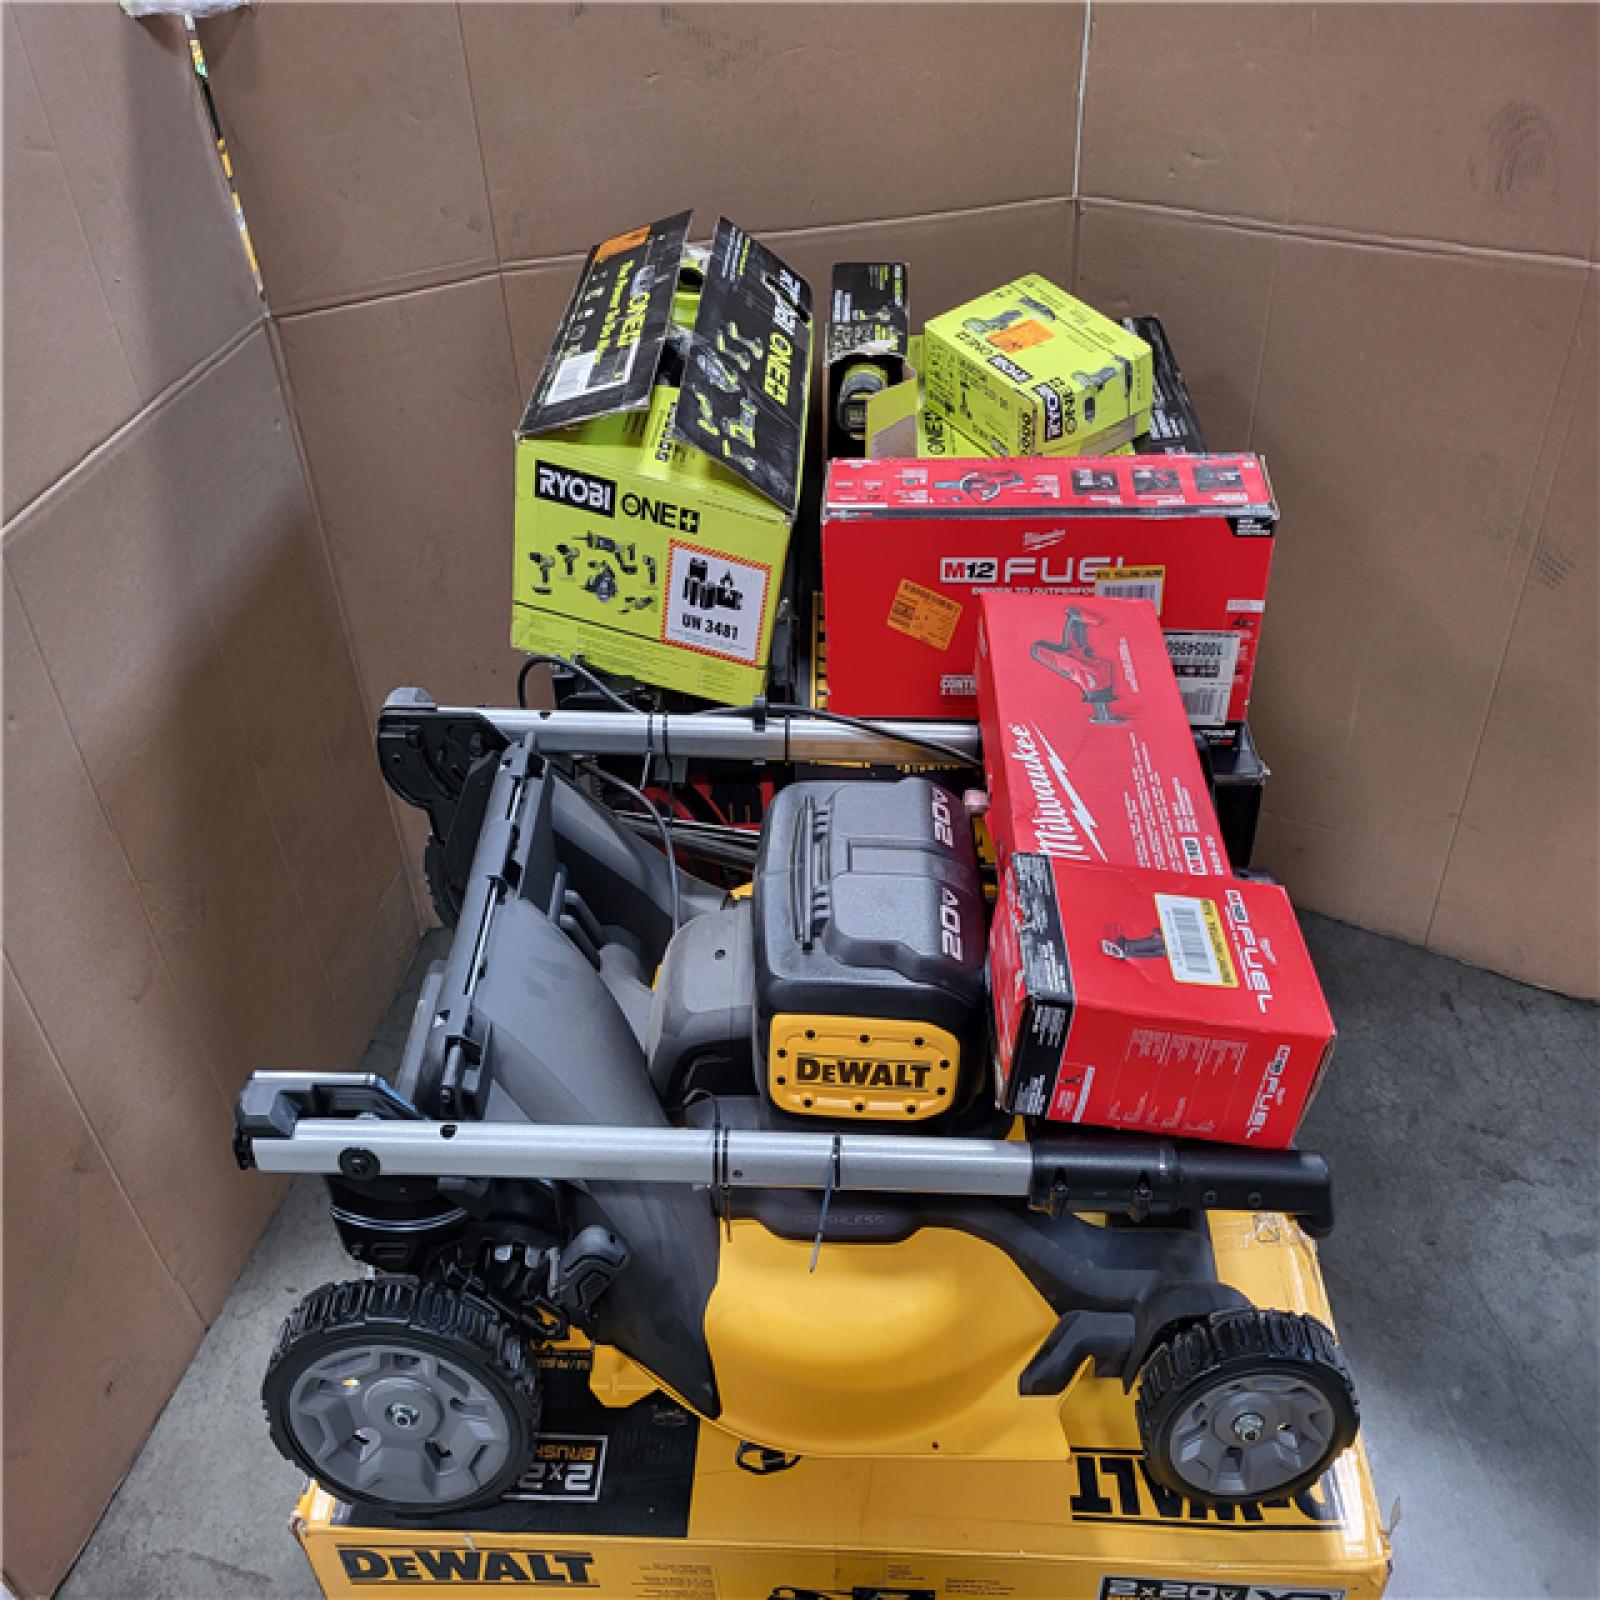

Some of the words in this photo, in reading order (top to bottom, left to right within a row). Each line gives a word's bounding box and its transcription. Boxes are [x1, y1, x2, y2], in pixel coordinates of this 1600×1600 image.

[538, 466, 611, 511] RYOBI
[620, 493, 700, 535] ONE+
[942, 559, 997, 581] M12
[682, 614, 702, 632] UN
[931, 786, 953, 848] 20V
[1008, 722, 1091, 861] Milwaukee
[939, 887, 963, 961] 20V
[1237, 922, 1273, 1013] FUEL
[338, 1549, 594, 1584] DEWALT
